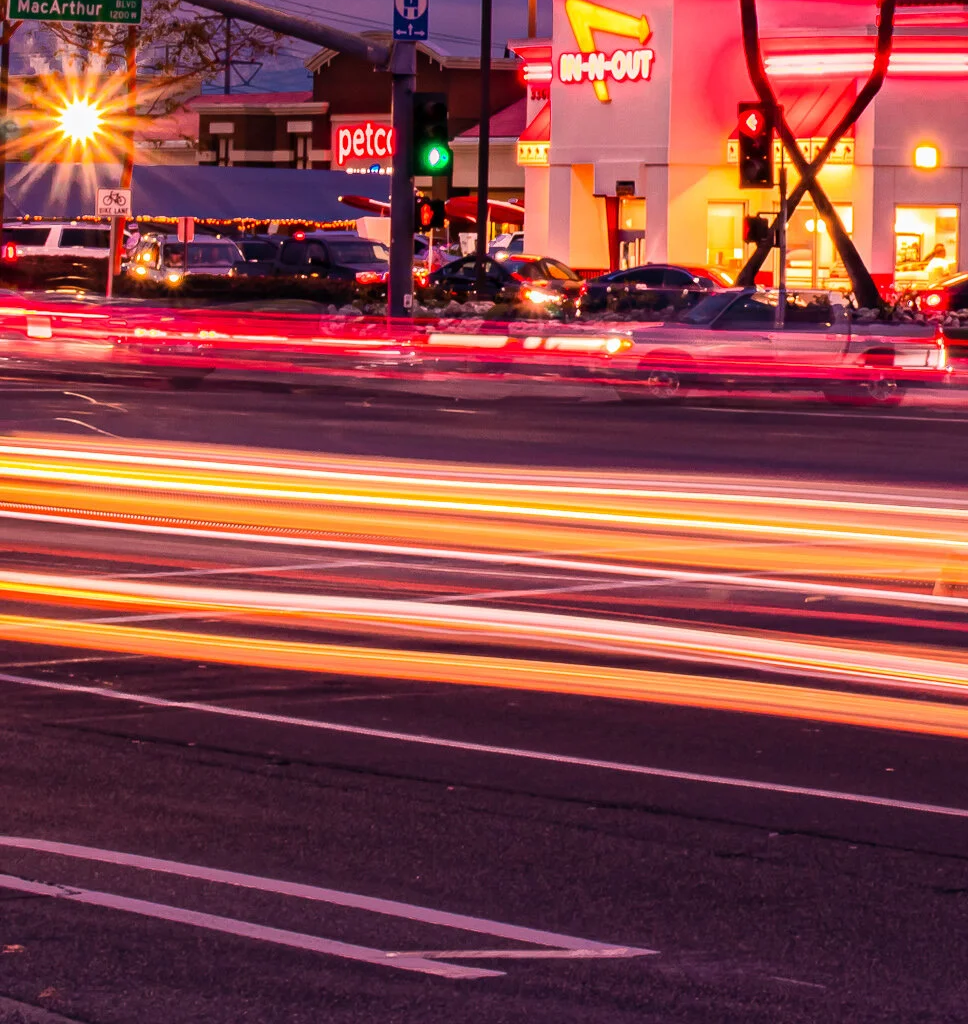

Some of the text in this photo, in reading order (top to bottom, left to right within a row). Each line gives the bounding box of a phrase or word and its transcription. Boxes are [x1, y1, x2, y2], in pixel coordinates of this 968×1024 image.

[115, 0, 137, 9] BLVD
[110, 10, 130, 19] 1200
[559, 49, 654, 82] IN-N-OUT
